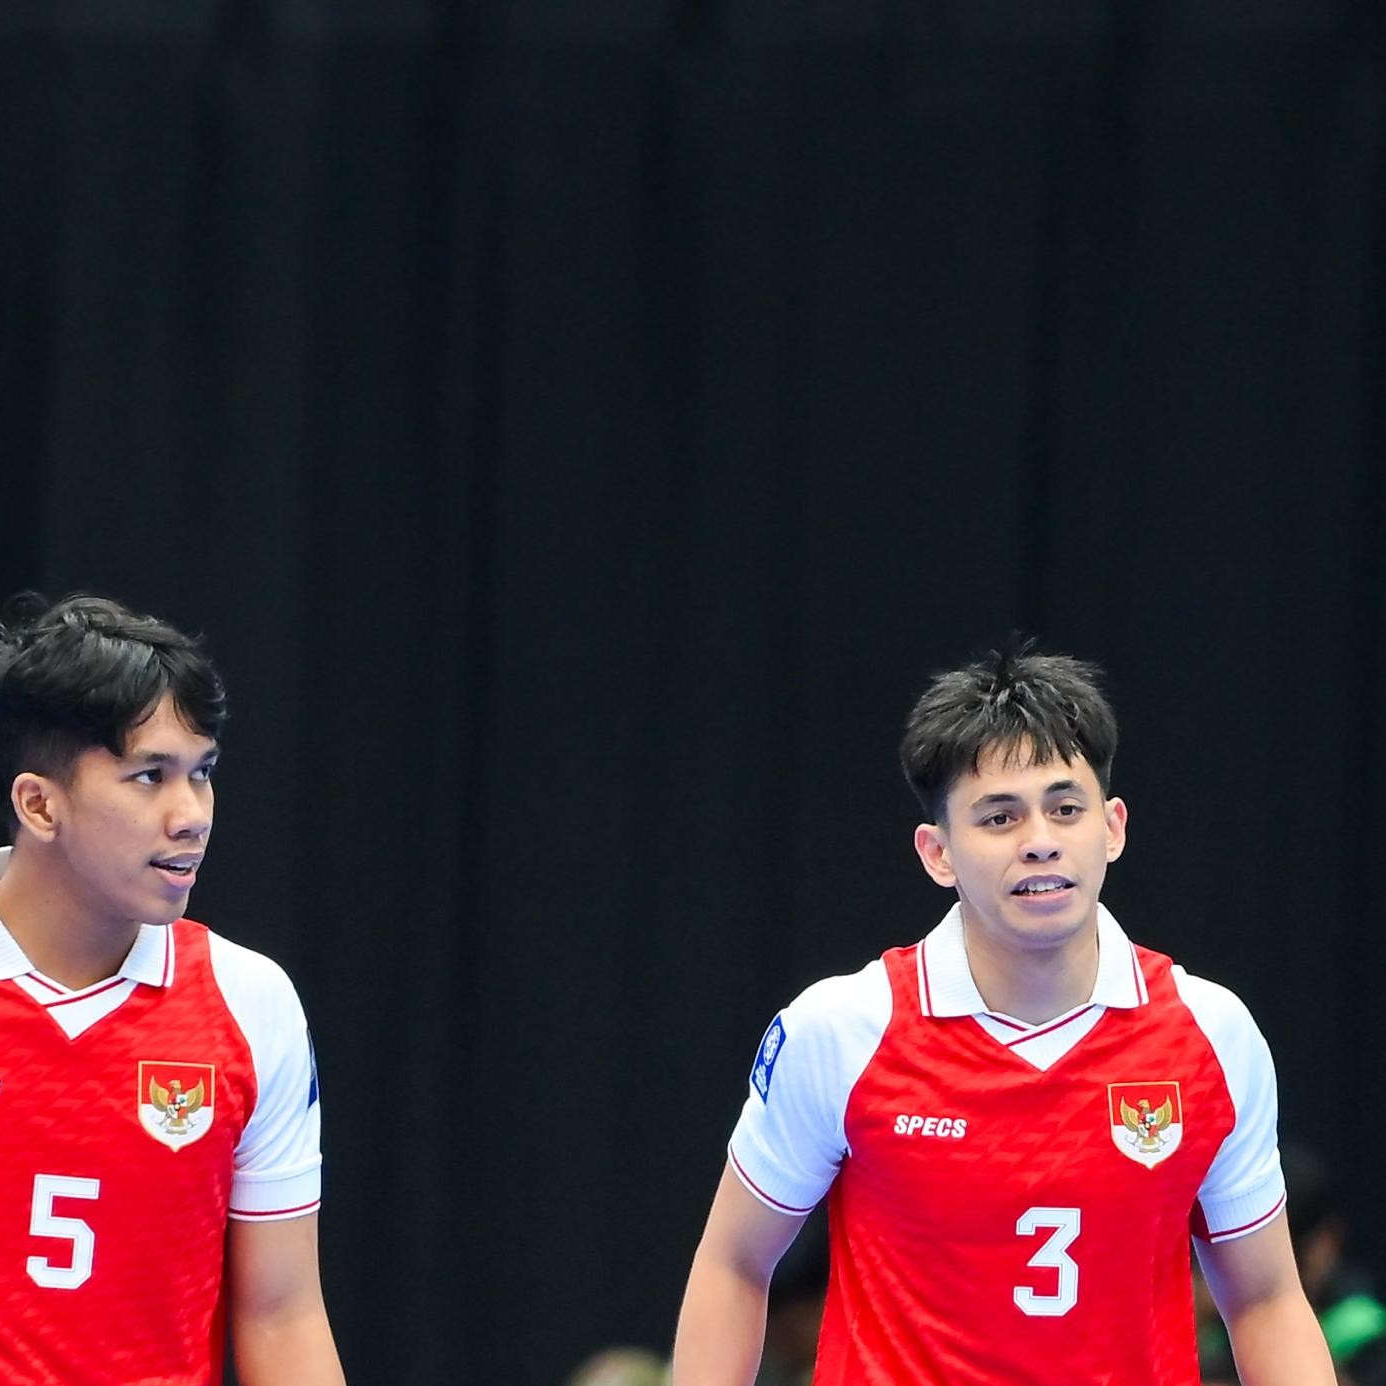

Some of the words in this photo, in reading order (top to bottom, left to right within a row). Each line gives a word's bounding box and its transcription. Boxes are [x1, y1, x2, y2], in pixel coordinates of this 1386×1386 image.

[893, 1114, 968, 1139] SPECS
[26, 1173, 101, 1291] 5
[1013, 1206, 1081, 1317] 3
